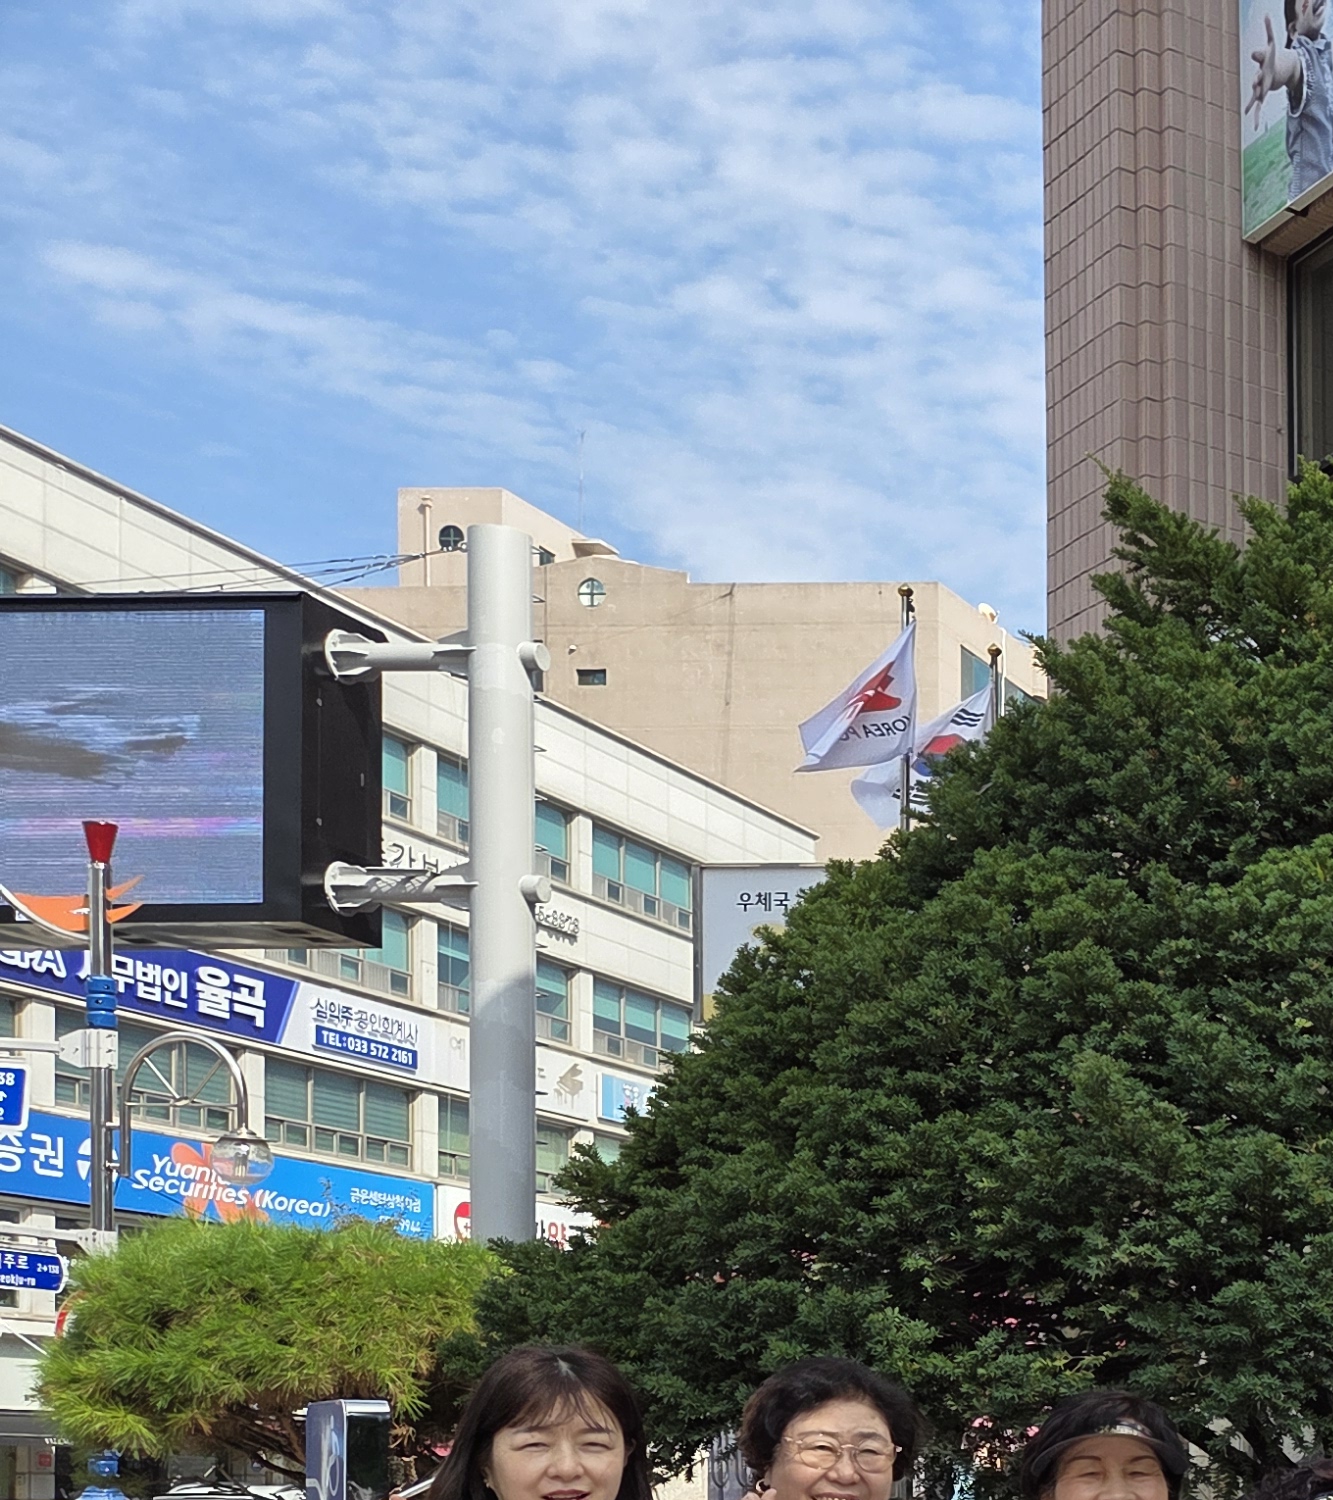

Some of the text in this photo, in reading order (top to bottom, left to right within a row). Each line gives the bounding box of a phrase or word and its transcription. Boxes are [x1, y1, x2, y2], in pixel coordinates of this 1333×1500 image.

[736, 891, 789, 910] 우체국
[77, 950, 188, 1008] 무법인
[195, 965, 267, 1028] 율곡
[370, 1043, 389, 1059] 572
[391, 1047, 413, 1066] 2161
[132, 1168, 332, 1218] Securities (Korea)
